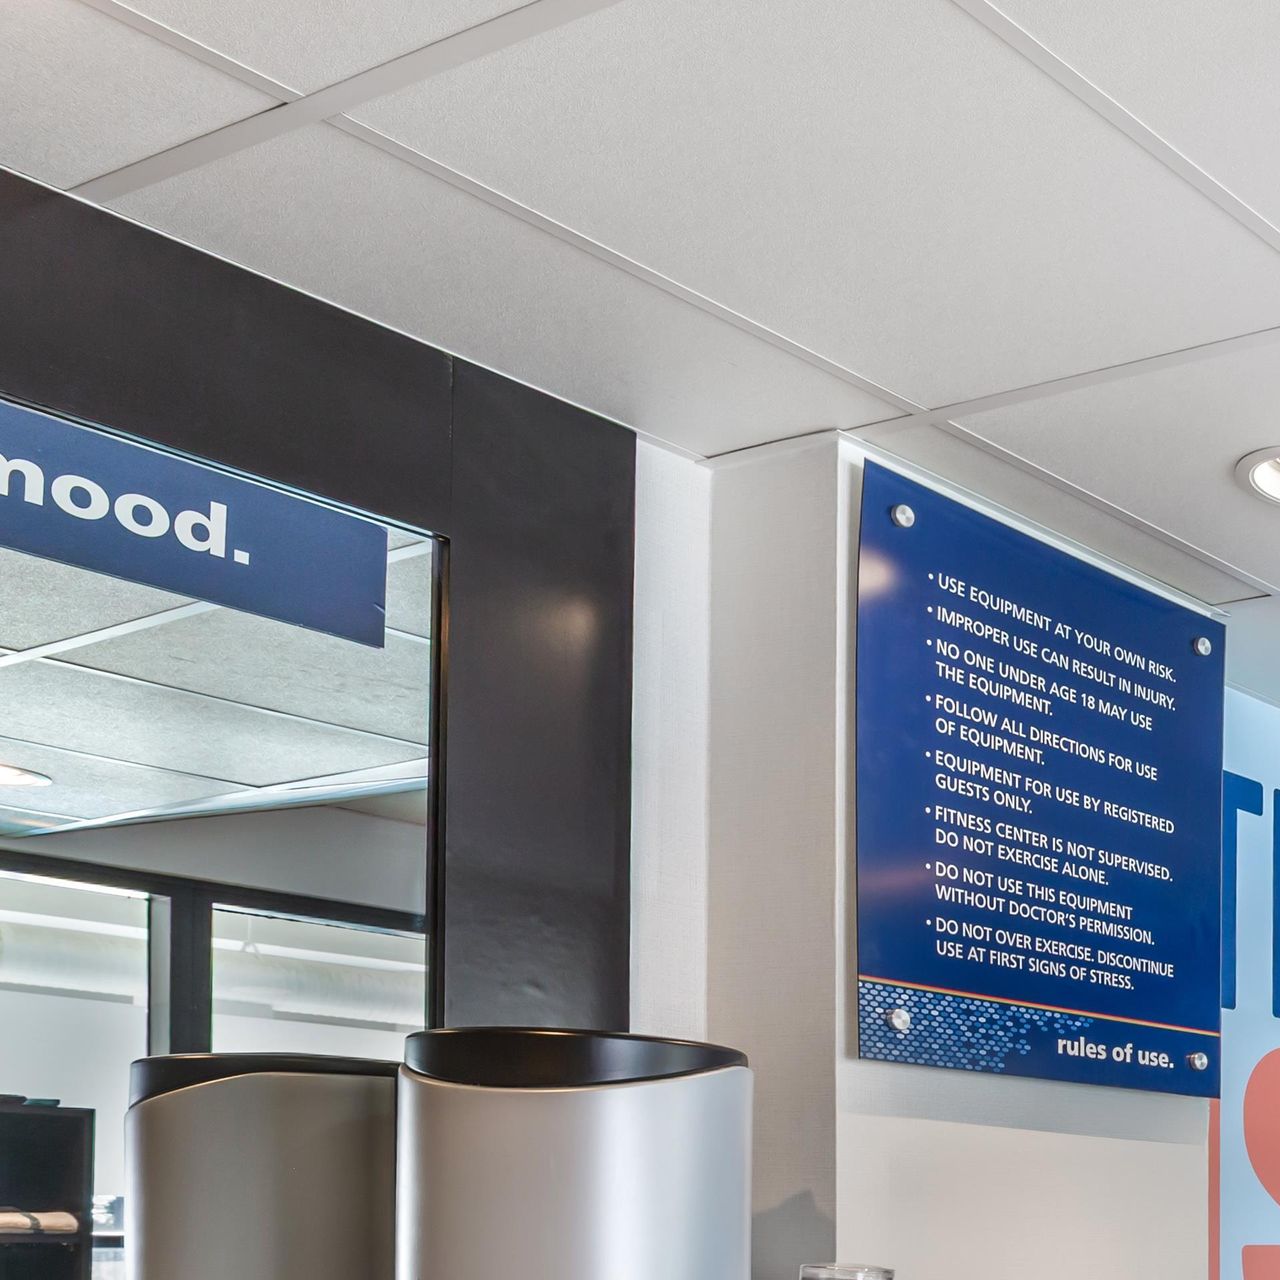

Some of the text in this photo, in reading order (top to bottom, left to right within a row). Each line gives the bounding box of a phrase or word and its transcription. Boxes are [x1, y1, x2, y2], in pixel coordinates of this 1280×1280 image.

[939, 573, 1176, 682] USE EQUIPMENT AT YOUR OWN RISK.
[937, 639, 1151, 730] NO ONE UNDER AGE 18 MAY USE
[938, 606, 1175, 710] IMPROPER USE CAN RESULT IN INJURY.
[936, 661, 1052, 715] THE EQUIPMENT.
[936, 694, 1157, 780] FOLLOW ALL DIRECTIONS FOR USE
[936, 718, 1044, 764] OF EQUIPMENT.
[936, 750, 1174, 833] EQUIPMENT FOR USE BY REGISTERED
[936, 774, 1032, 813] GUESTS ONLY.
[936, 806, 1172, 881] FITNESS CENTER IS NOT SUPERVISED.
[936, 829, 1108, 885] DO NOT EXERCISE ALONE.
[935, 884, 1154, 944] WITHOUT DOCTOR'S PERMISSION.
[936, 862, 1132, 919] DO NOT USE THIS EQUIPMENT
[937, 918, 1173, 977] DO NOT OVER EXERCISE. DISCONTINUE
[937, 940, 1133, 989] USE AT FIRST SIGNS OF STRESS.
[1057, 1037, 1173, 1068] rules of use.
